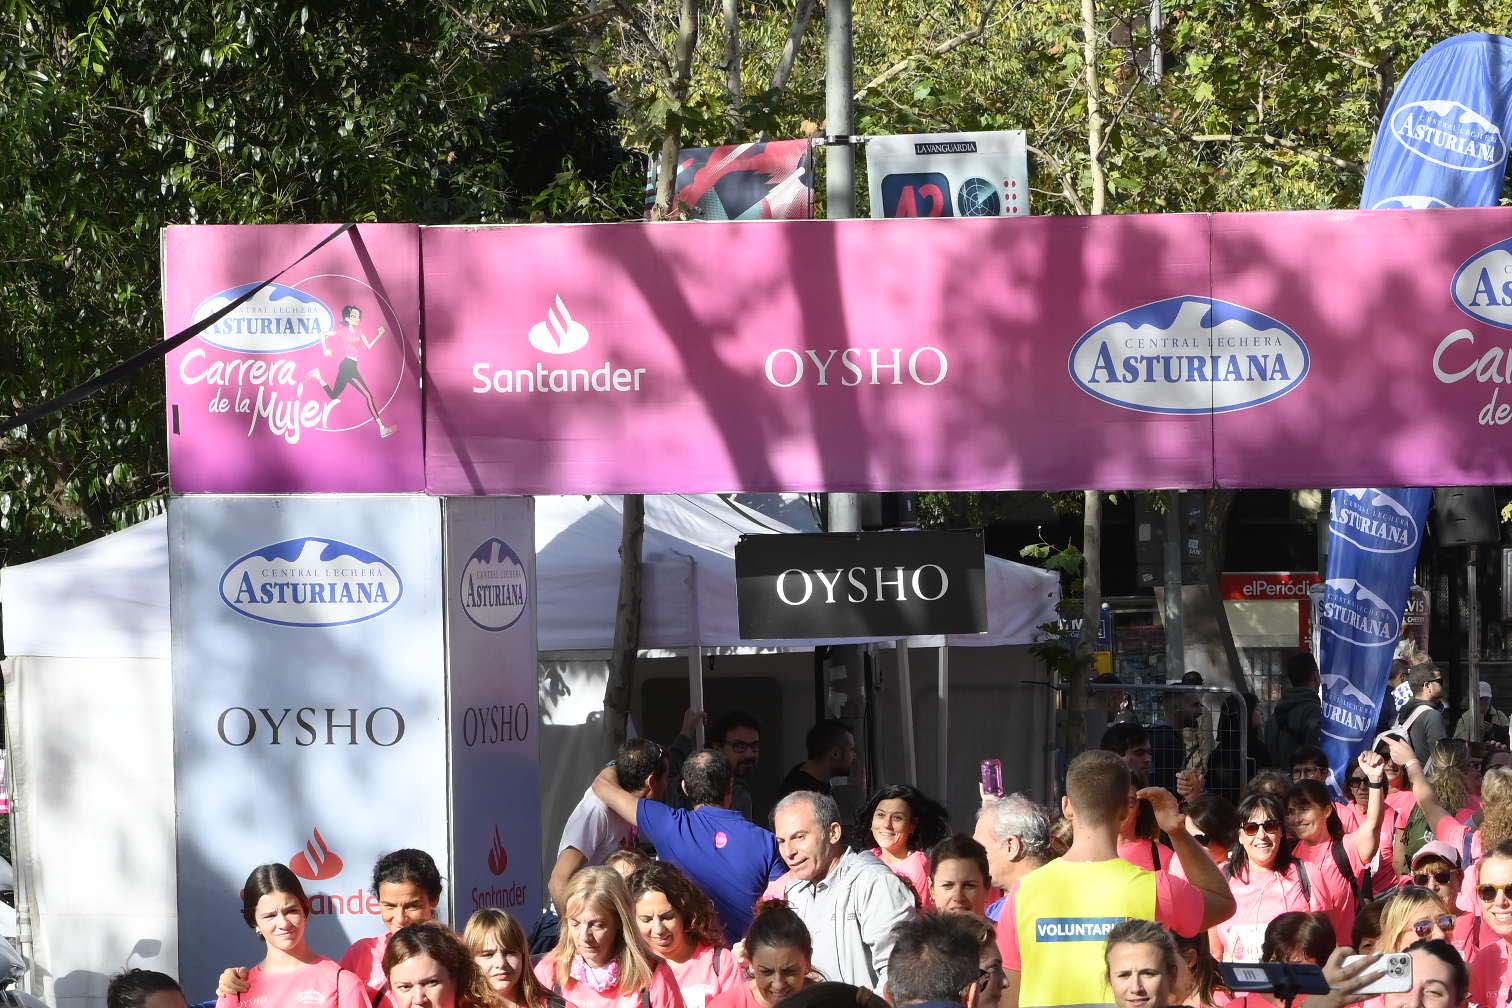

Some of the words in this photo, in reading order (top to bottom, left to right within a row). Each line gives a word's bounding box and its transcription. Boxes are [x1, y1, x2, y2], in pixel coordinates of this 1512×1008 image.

[1397, 112, 1496, 162] ASTURIANA
[1125, 336, 1199, 349] CENTRAL
[1208, 335, 1283, 348] LECHERA
[179, 350, 298, 387] Carrera
[472, 361, 646, 394] Santander
[764, 345, 949, 388] OYSHO
[1088, 341, 1291, 384] ASTURIANA
[208, 394, 231, 415] de
[235, 389, 251, 415] la
[249, 386, 341, 445] Mujer
[1478, 387, 1511, 426] de
[1330, 498, 1409, 546] ASTURIANA
[233, 572, 390, 605] ASTURIANA
[261, 568, 318, 577] CENTRAL
[325, 567, 383, 577] LECHERA
[466, 573, 524, 608] ASTURIANA
[776, 564, 949, 605] OYSHO
[1323, 602, 1391, 639] STURIANA
[217, 706, 406, 747] OYSHO
[463, 702, 529, 747] OYSHO
[471, 880, 527, 911] Santander
